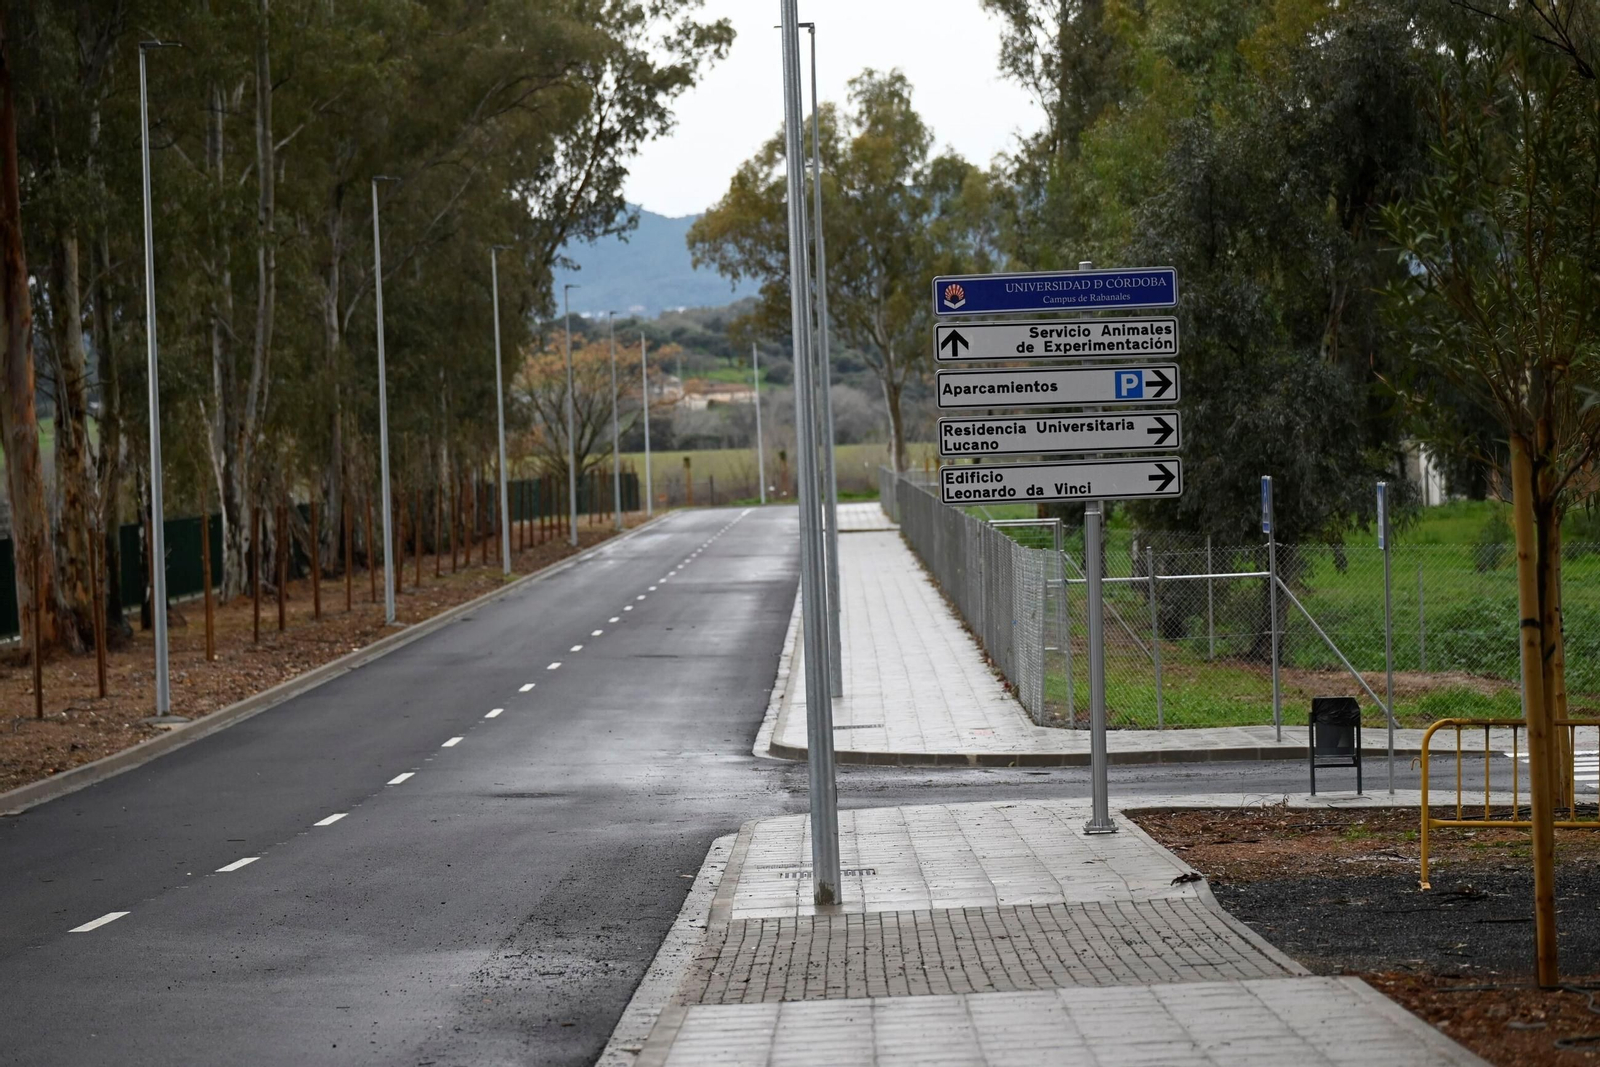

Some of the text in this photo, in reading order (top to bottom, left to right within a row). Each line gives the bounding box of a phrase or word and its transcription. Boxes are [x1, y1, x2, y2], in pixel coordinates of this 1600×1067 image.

[1005, 281, 1091, 293] UNIVERSIDAD
[1106, 276, 1167, 288] CÓRDOBA
[1043, 293, 1130, 304] Campus de Rabanales
[1029, 324, 1172, 339] Servicio Animales
[1016, 337, 1173, 354] de Experimentación
[942, 381, 1058, 397] Aparcamientos
[1121, 374, 1138, 396] P
[944, 419, 1135, 436] Residencia Universitaria
[944, 439, 999, 451] Lucano
[945, 471, 1003, 484] Edificio
[946, 482, 1091, 499] Leonardo da Vinci
